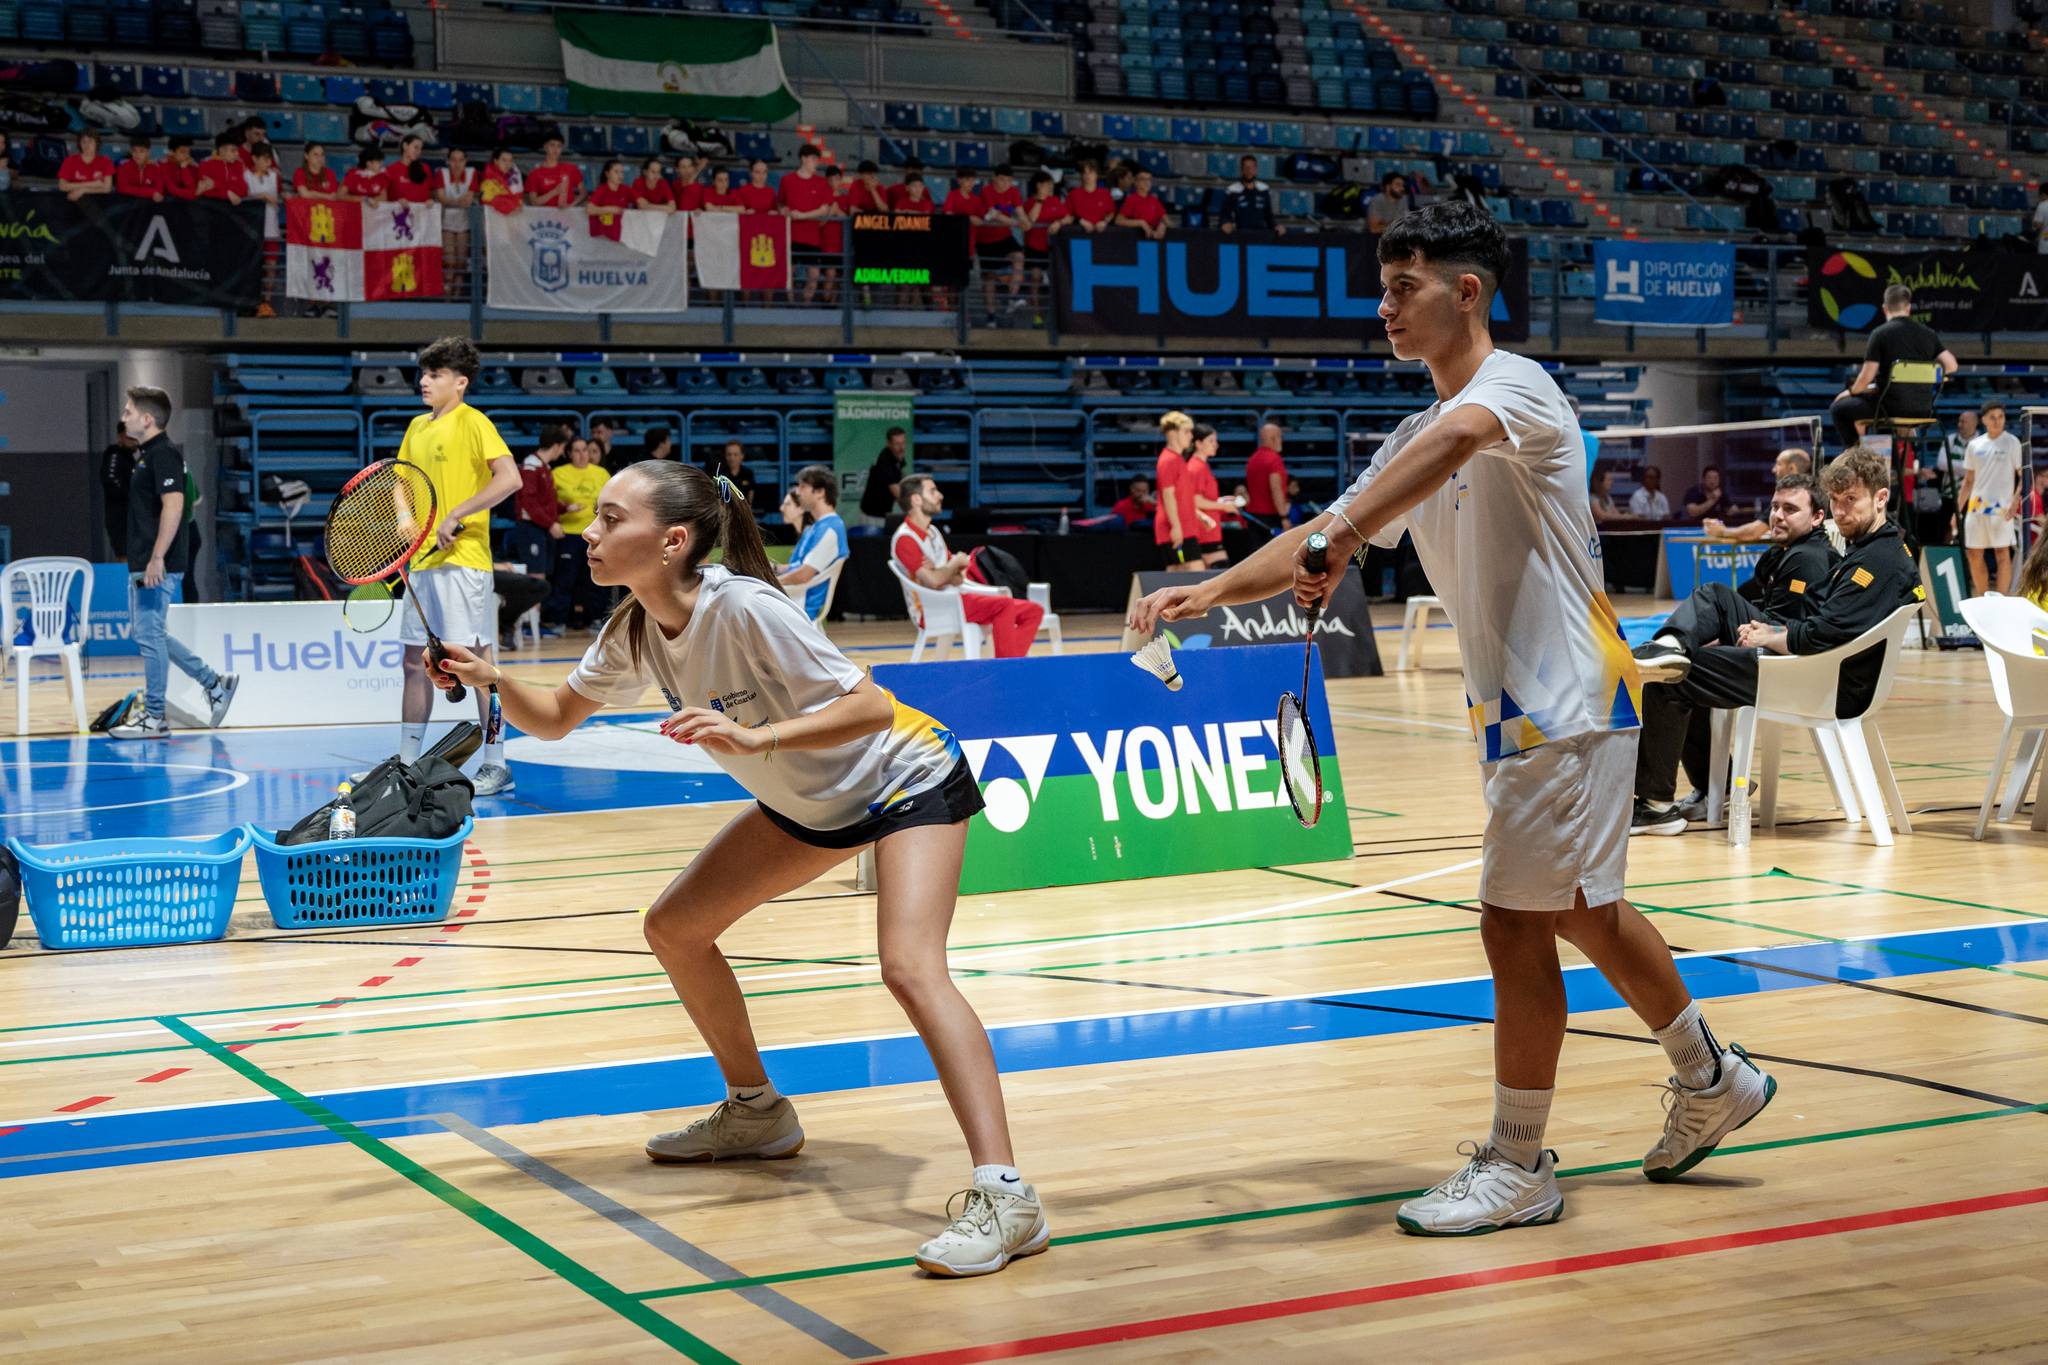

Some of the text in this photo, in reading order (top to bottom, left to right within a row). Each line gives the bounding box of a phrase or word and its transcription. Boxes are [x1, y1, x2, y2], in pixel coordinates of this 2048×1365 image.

[108, 265, 140, 276] Junta
[156, 265, 211, 280] Andalucía
[578, 270, 648, 286] HUELVA
[1070, 239, 1511, 319] HUEL
[1644, 260, 1729, 278] DIPUTACIÓN
[1644, 280, 1721, 297] DE HUELVA
[1692, 544, 1763, 569] Huelv
[1936, 556, 1962, 614] 1
[1220, 604, 1356, 642] Andaluía
[224, 629, 405, 672] Huelva
[347, 674, 405, 692] origina
[1071, 718, 1325, 822] YONEX
